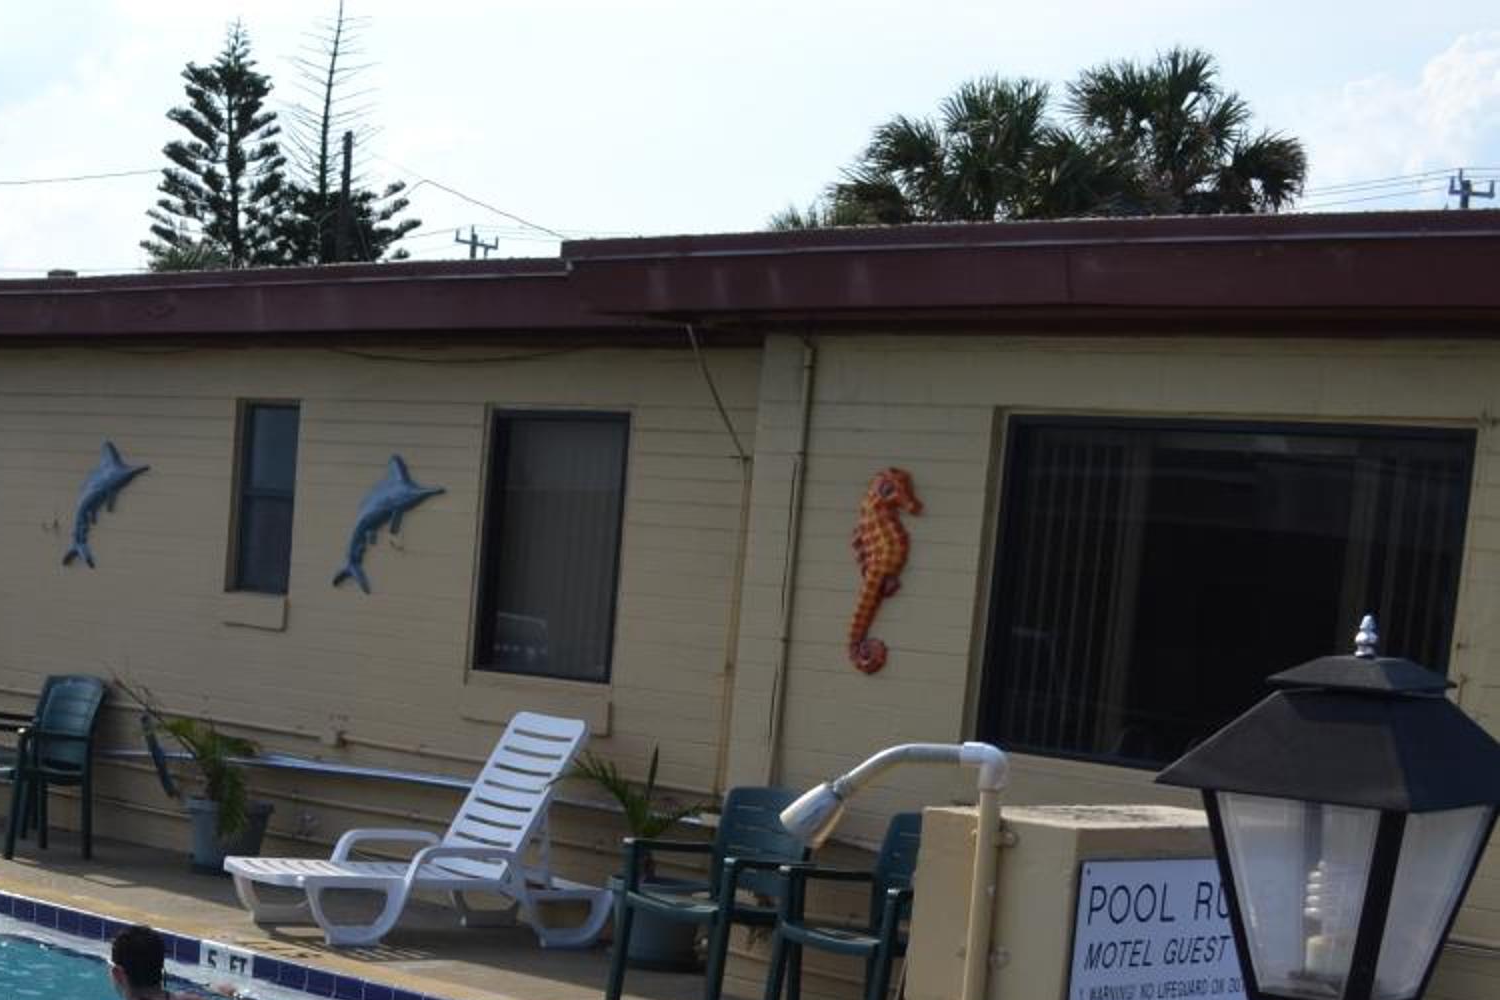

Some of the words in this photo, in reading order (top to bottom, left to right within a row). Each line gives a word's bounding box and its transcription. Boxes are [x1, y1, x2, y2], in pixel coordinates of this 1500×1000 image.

[1087, 881, 1176, 926] POOL
[1193, 881, 1231, 921] RU
[207, 948, 218, 970] 5
[229, 954, 248, 975] FT
[1083, 939, 1154, 971] MOTEL
[1162, 935, 1232, 966] GUEST
